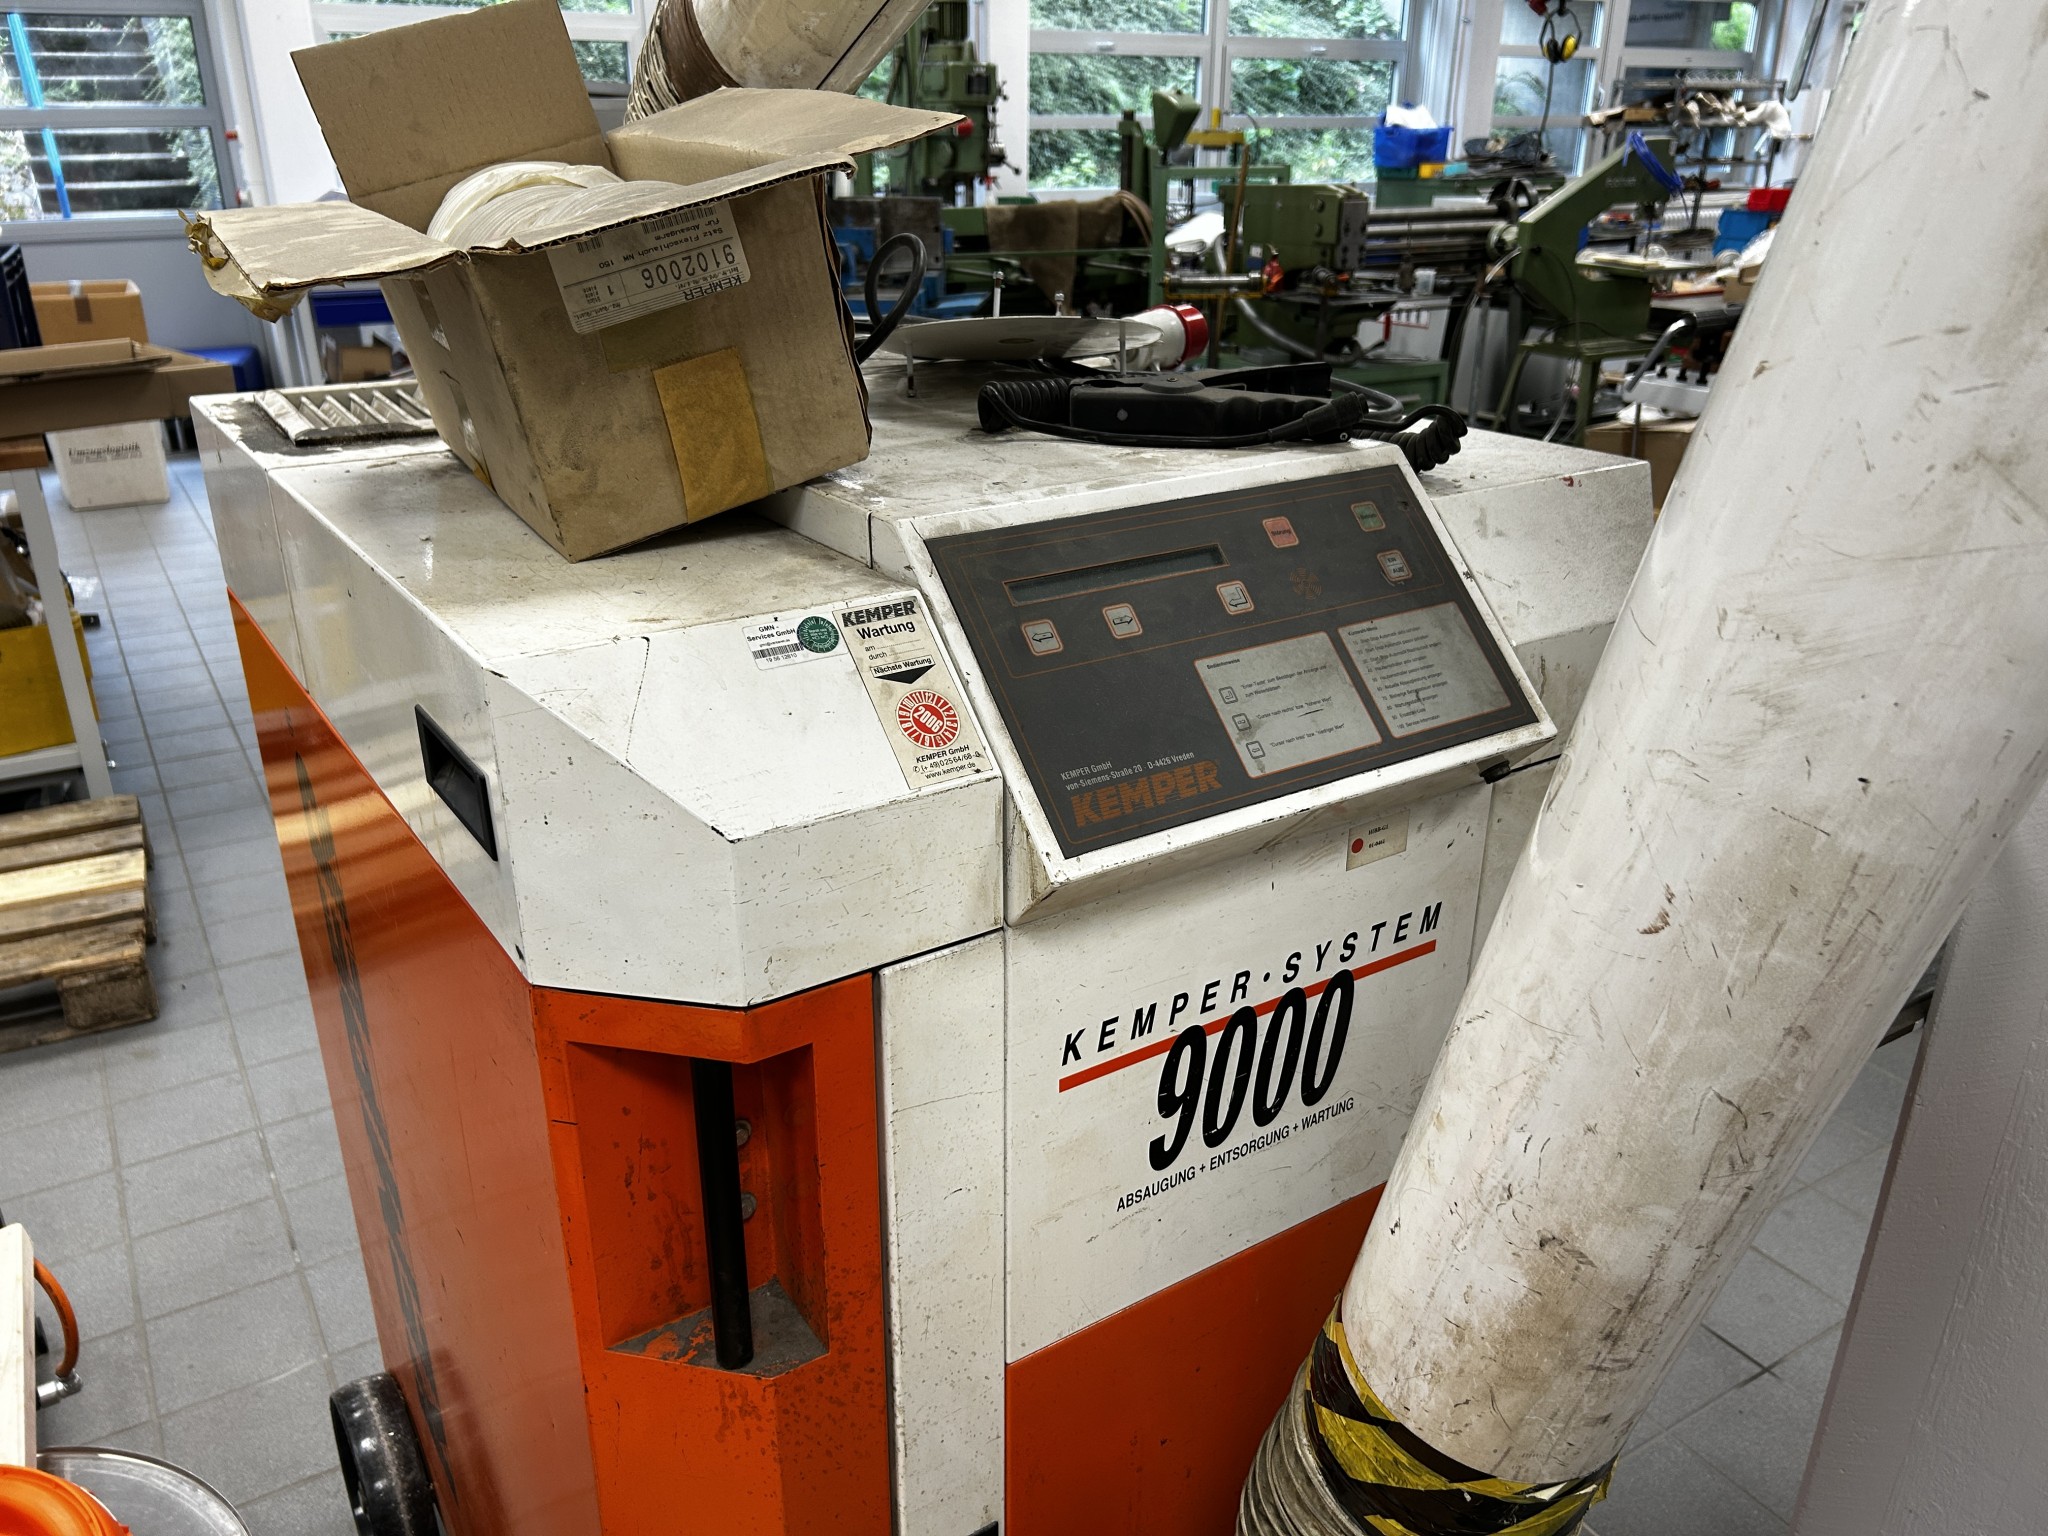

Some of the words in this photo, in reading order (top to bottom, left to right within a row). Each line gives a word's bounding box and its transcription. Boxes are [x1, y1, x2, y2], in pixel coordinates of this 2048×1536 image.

[705, 217, 720, 228] für
[654, 224, 701, 242] Absaugarm
[702, 227, 724, 238] Satz
[638, 235, 700, 258] Flexschlauch
[598, 259, 614, 269] 150
[623, 254, 635, 263] NW
[641, 243, 735, 289] 9102006
[607, 285, 615, 296] 1
[683, 275, 742, 300] KEMPER
[841, 600, 917, 628] KEMPER
[746, 632, 775, 642] Services
[775, 627, 796, 637] GmbH
[758, 624, 775, 632] GMN
[857, 621, 916, 640] Wartung
[864, 644, 876, 652] am
[868, 650, 888, 661] durch
[873, 662, 903, 675] Nächste
[902, 657, 933, 670] Wartung
[902, 698, 914, 708] 10
[912, 692, 922, 703] 11
[925, 692, 933, 703] 12
[913, 705, 943, 733] 2006
[911, 731, 919, 741] 7
[924, 736, 930, 747] 6
[936, 736, 944, 746] 5
[944, 731, 954, 740] 4
[915, 750, 947, 763] KEMPER
[948, 744, 970, 755] GmbH
[925, 762, 976, 779] www.kemper.de
[1060, 766, 1091, 781] KEMPER
[1091, 761, 1113, 773] GmbH
[1065, 767, 1134, 791] von-Siemens-Straße
[1133, 764, 1143, 773] 20
[1147, 757, 1171, 770] D-4426
[1170, 751, 1195, 763] Vreden
[1070, 759, 1222, 828] KEMPER
[1149, 968, 1355, 1172] 9000
[1116, 1166, 1196, 1212] ABSAUGUNG
[1209, 1125, 1290, 1171] ENTSORGUNG
[1300, 1097, 1355, 1131] WARTUNG
